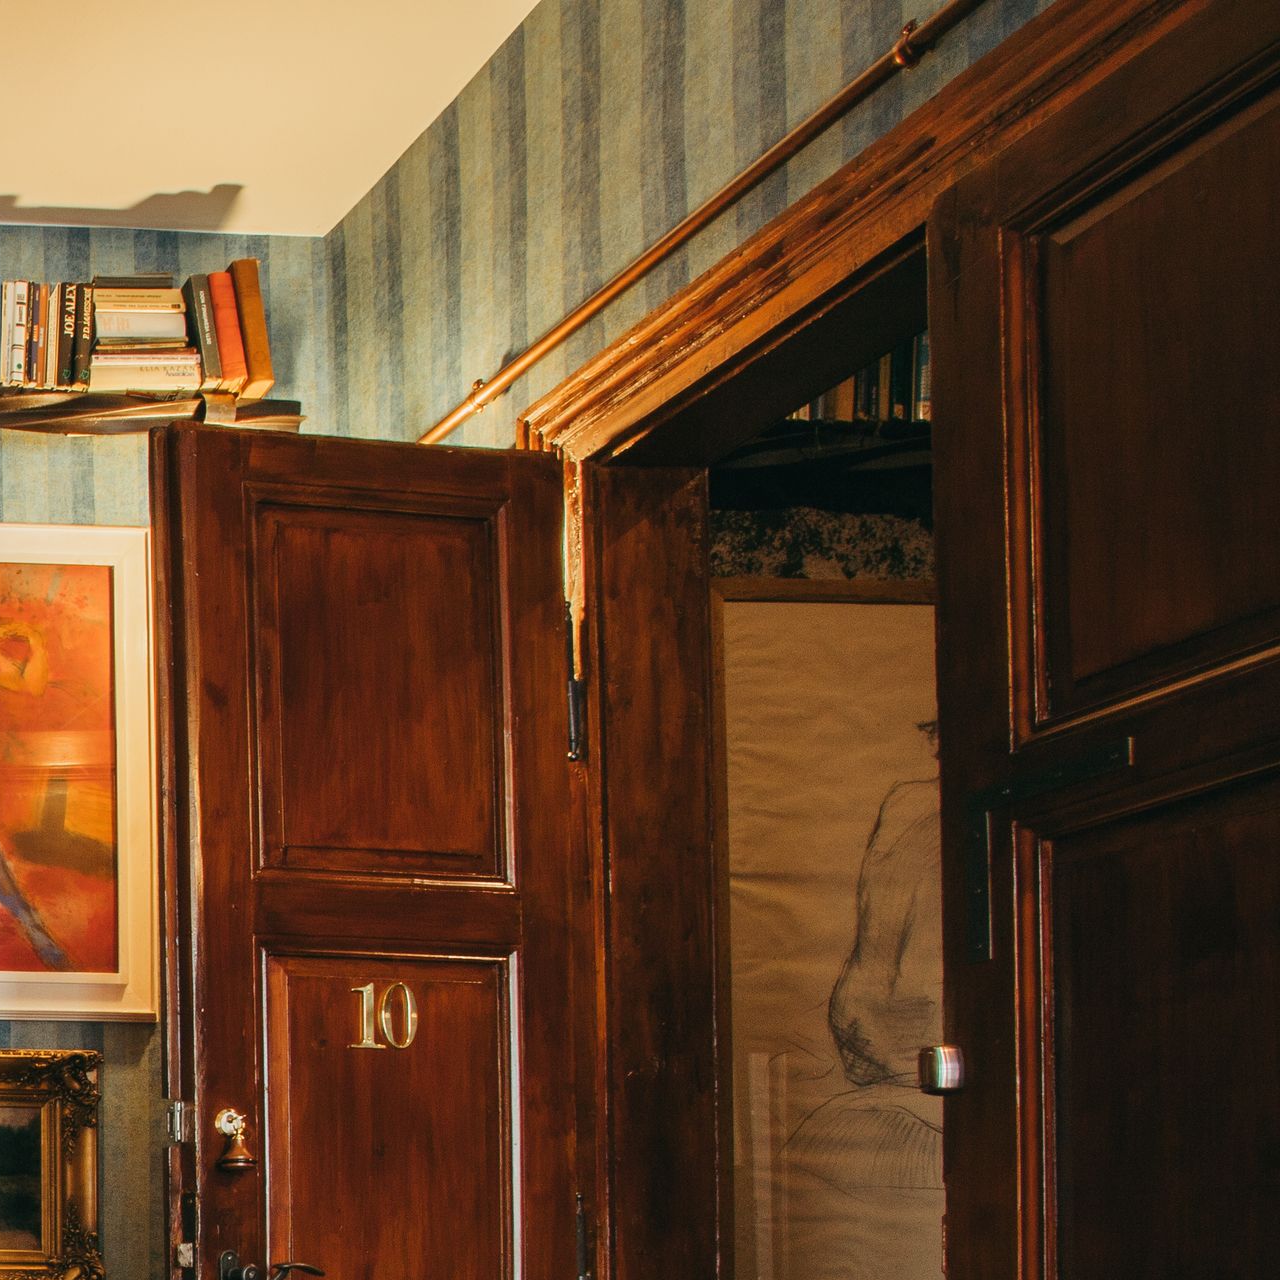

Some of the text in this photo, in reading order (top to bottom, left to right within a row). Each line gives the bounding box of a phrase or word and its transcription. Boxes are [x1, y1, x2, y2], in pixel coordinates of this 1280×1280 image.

[64, 284, 77, 338] JOE ALEX
[347, 981, 419, 1049] 10
